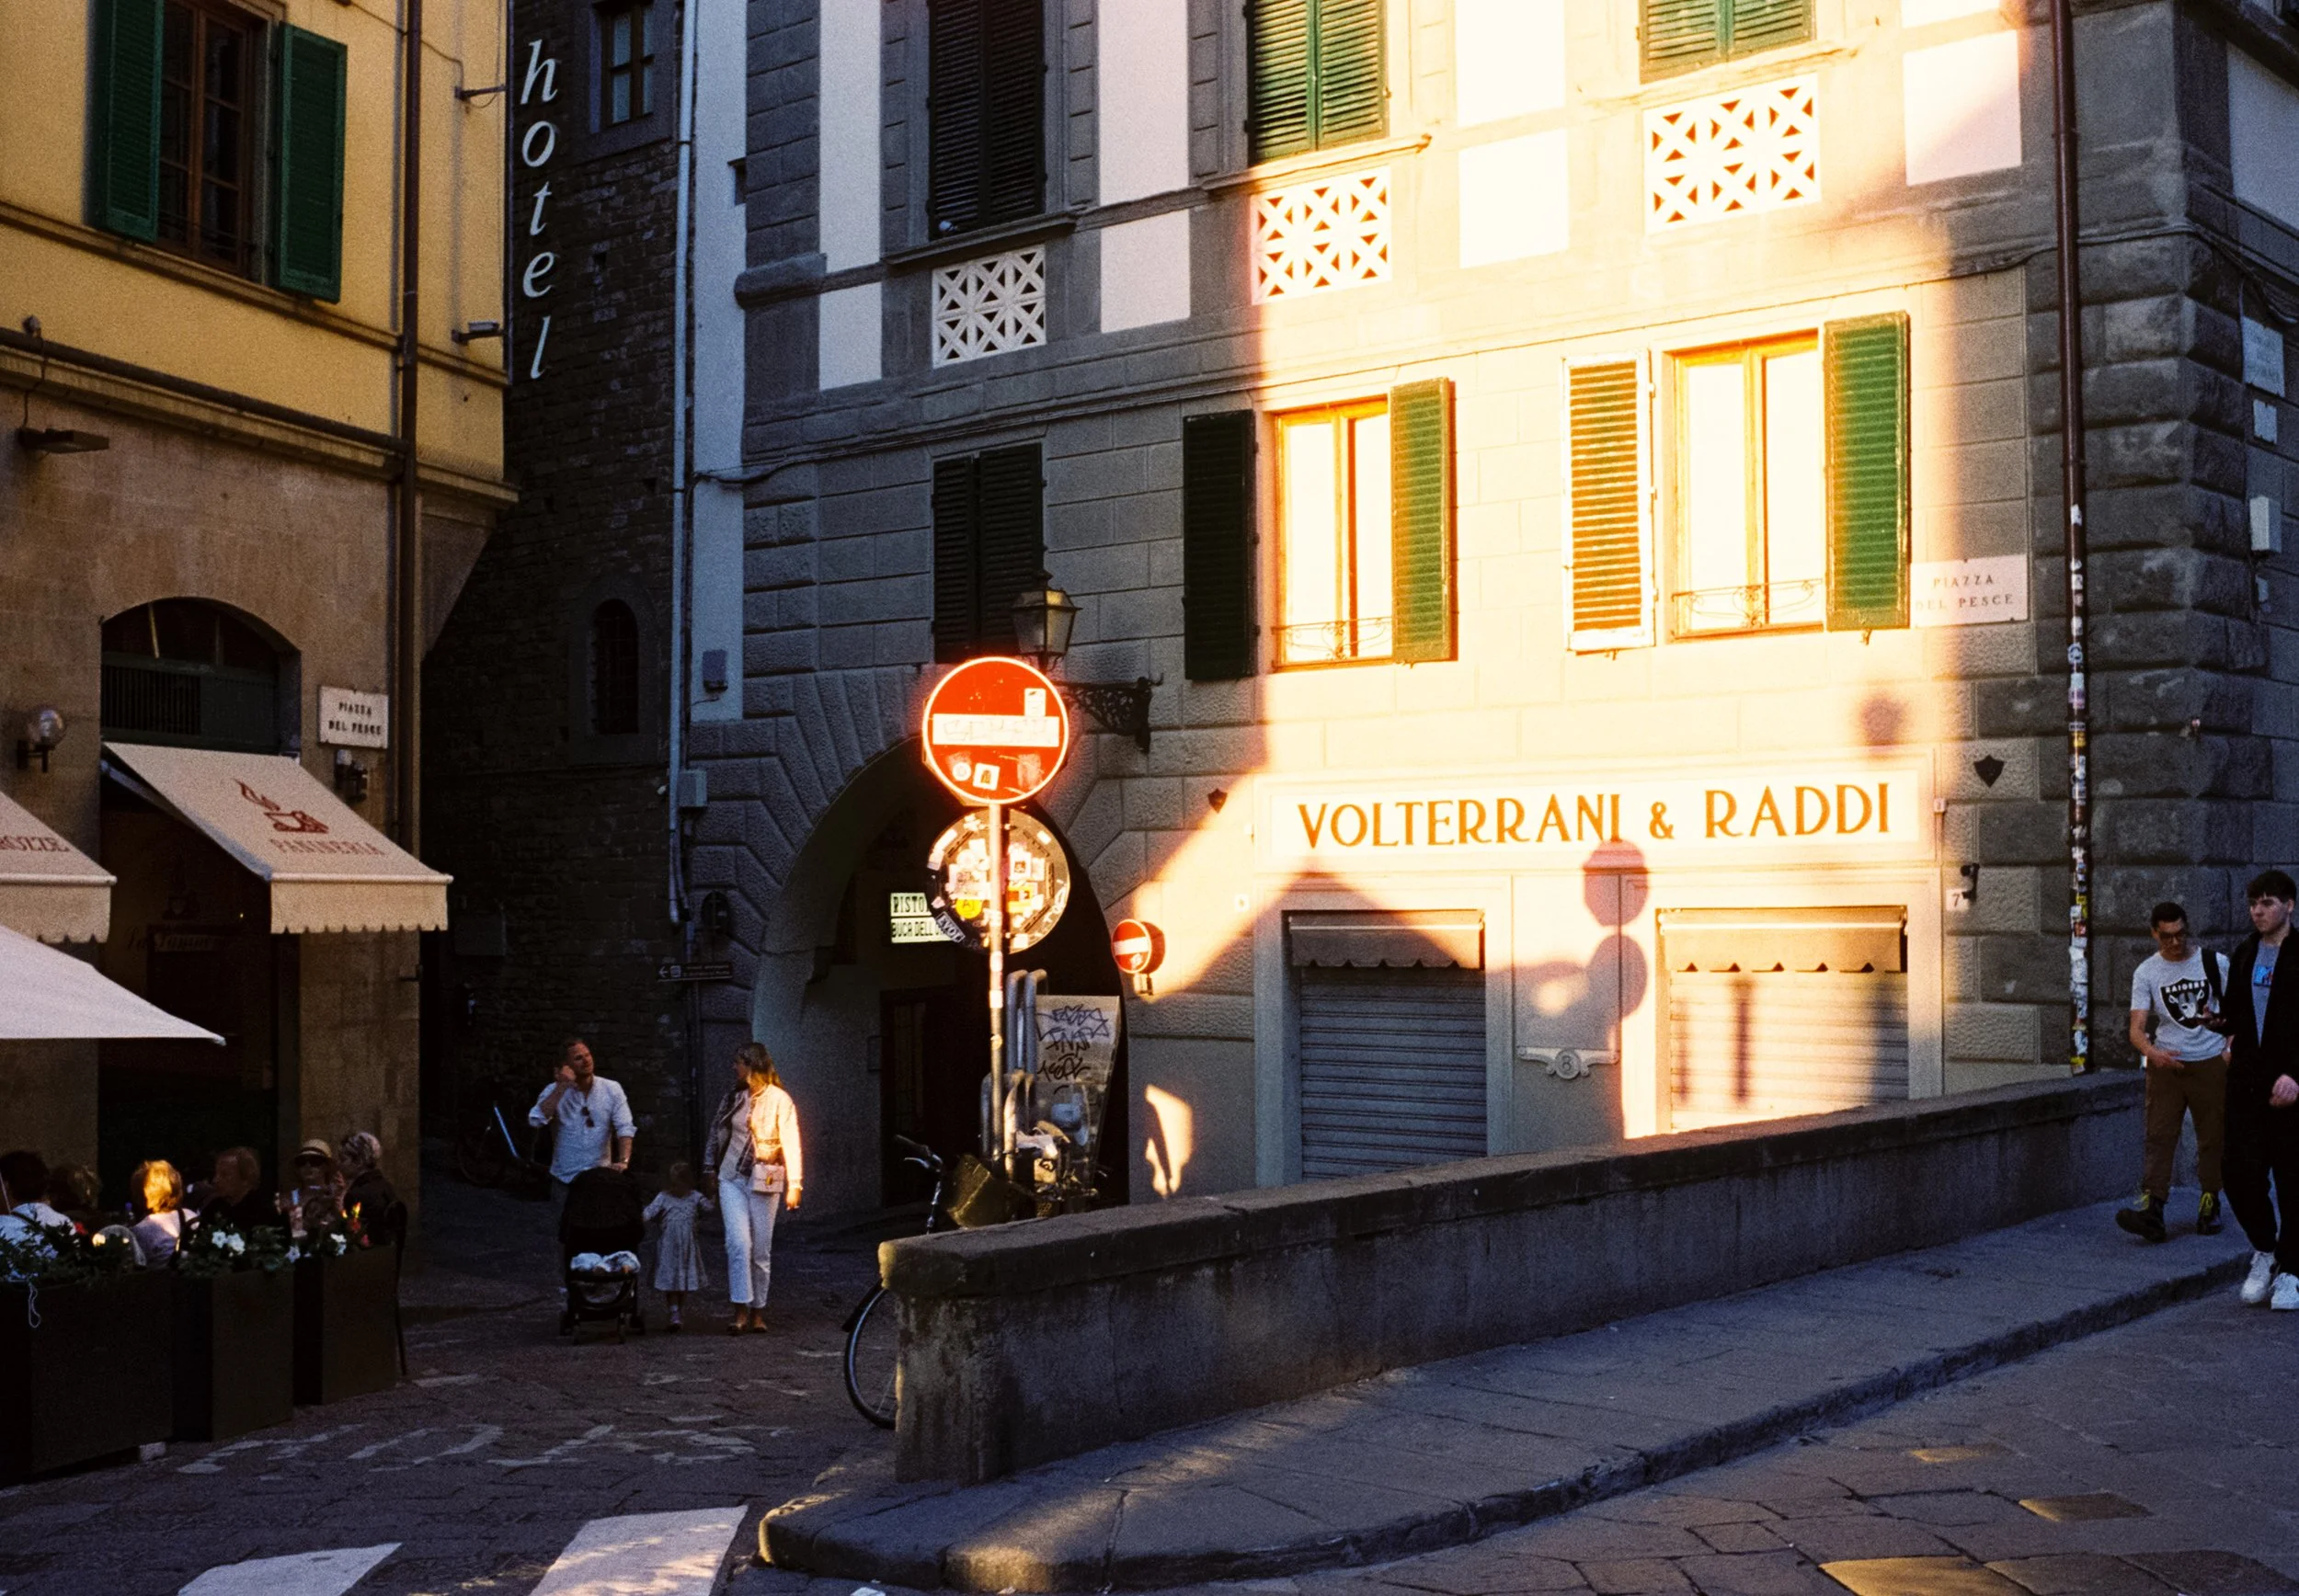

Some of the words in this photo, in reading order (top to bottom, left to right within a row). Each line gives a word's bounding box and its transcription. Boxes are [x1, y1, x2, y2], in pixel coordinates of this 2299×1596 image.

[520, 39, 559, 379] hotel
[1932, 575, 1994, 588] PIAZZA
[1916, 599, 1948, 611] DEL
[1958, 594, 2015, 609] PESCE
[338, 701, 372, 716] PIAZZA
[328, 720, 347, 732] DEL
[351, 723, 382, 735] PESCE
[1298, 792, 1622, 849] VOLTERRANI
[1649, 802, 1675, 840] &
[1704, 782, 1891, 838] RADDI
[270, 838, 385, 855] PANINERIA
[893, 896, 929, 912] RISTO
[1951, 893, 1961, 907] 7
[2165, 980, 2205, 993] RAIDERS
[1562, 1054, 1572, 1071] 8
